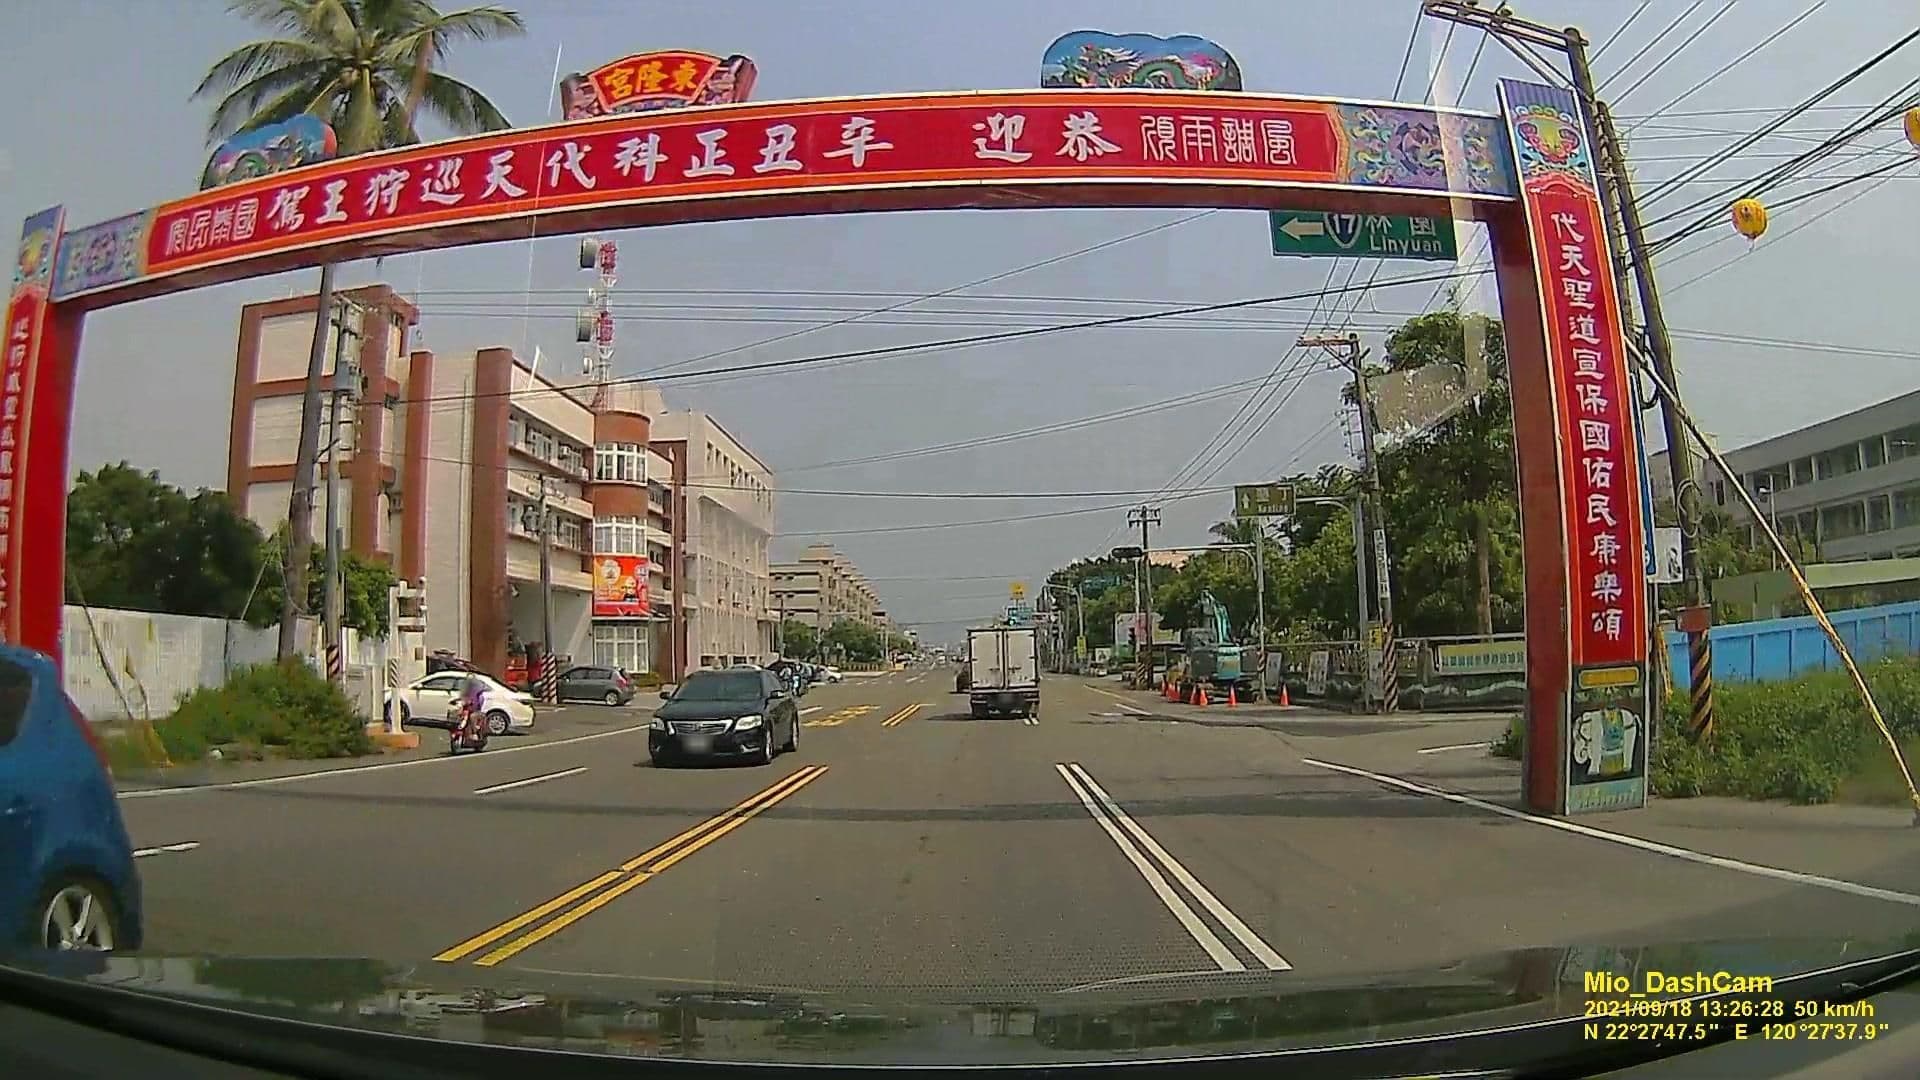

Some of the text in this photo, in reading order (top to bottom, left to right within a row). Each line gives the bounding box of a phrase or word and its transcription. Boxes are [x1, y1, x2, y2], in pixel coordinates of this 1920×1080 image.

[605, 59, 699, 99] 東隆宮
[1370, 234, 1442, 255] Linyuan
